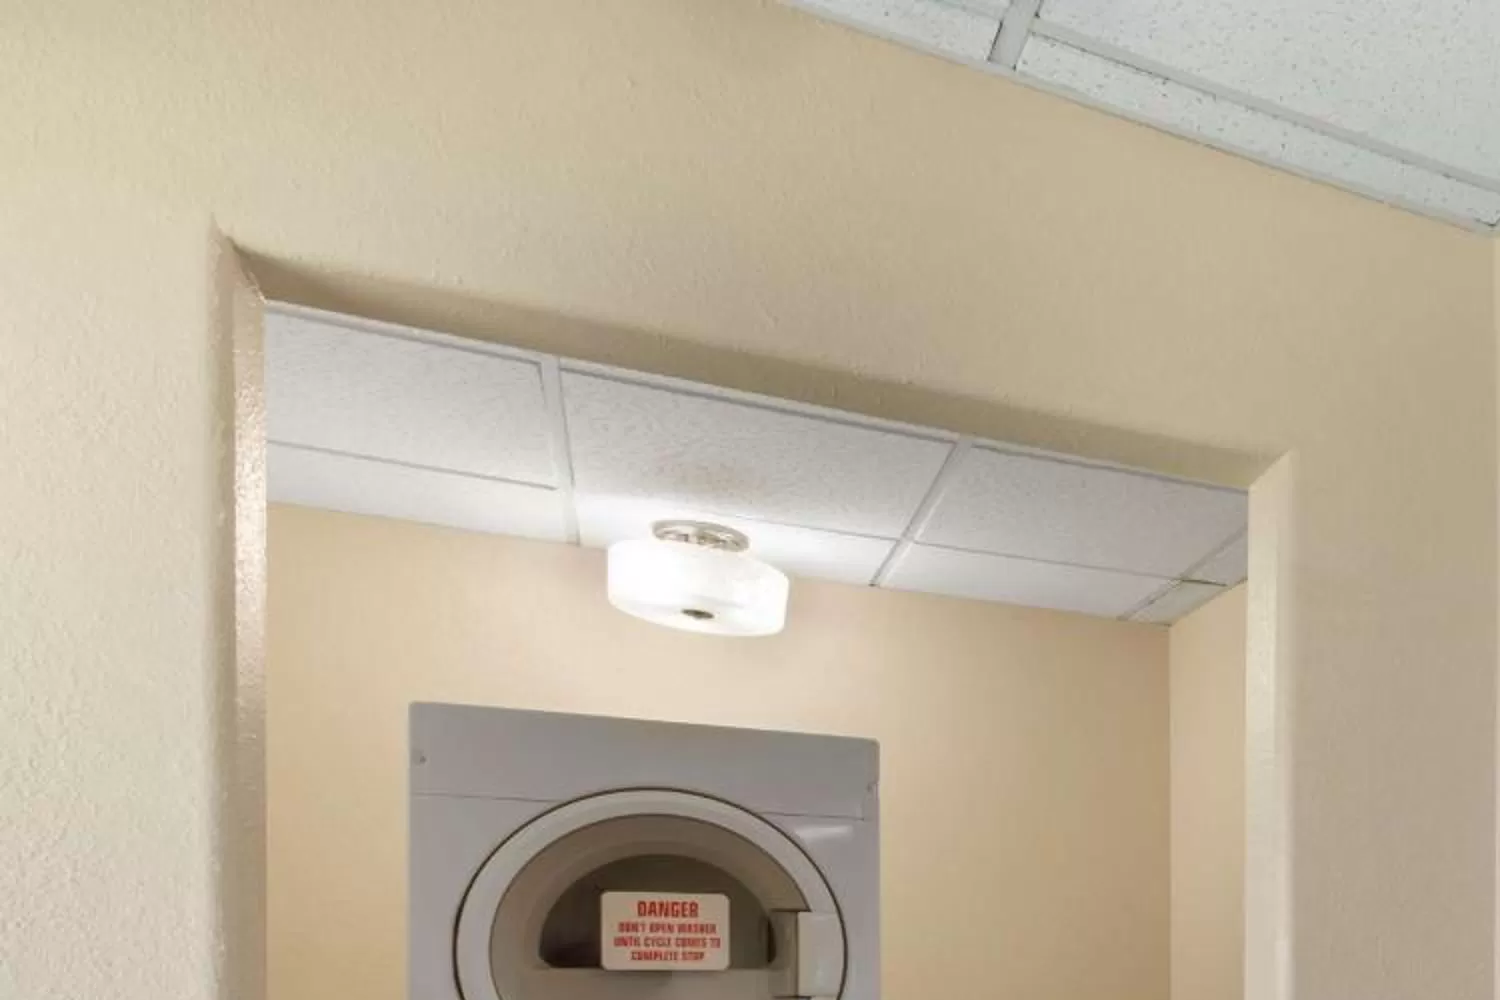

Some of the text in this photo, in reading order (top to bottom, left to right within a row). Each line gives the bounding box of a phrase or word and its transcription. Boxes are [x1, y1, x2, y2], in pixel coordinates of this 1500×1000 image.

[637, 900, 699, 918] DANGER
[618, 922, 717, 934] DON'T OPEN WASHER
[613, 936, 721, 949] UNTIL CYCLE COMES TO
[630, 951, 705, 961] COMPLETE STOP
